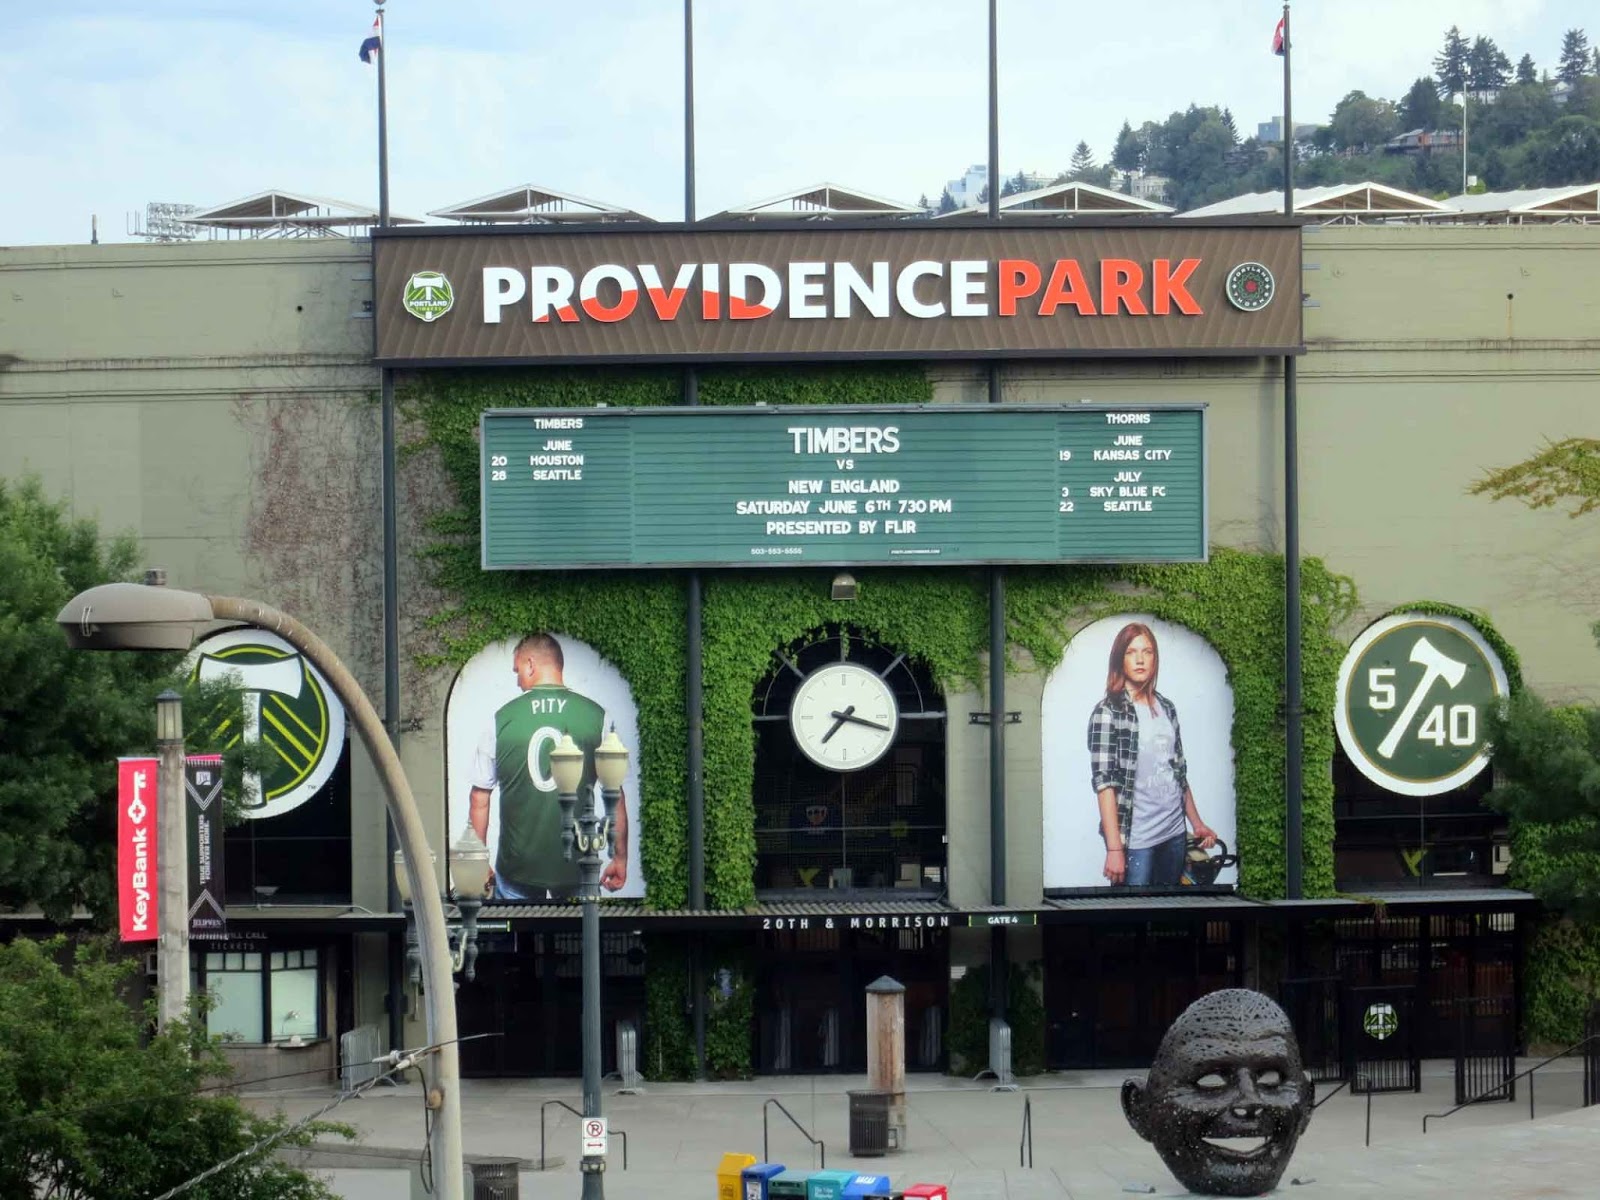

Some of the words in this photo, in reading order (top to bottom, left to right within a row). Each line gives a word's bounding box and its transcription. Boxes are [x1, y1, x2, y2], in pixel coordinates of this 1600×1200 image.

[533, 418, 584, 430] TIMBERS
[1106, 413, 1151, 425] THORNS
[542, 440, 573, 451] JUNE
[787, 426, 900, 454] TIMBERS
[1113, 435, 1143, 446] JUNE
[491, 455, 508, 467] 20
[530, 455, 584, 466] HOUSTON
[1059, 450, 1071, 461] 19
[1093, 450, 1140, 461] KANSAS
[1144, 449, 1172, 461] CITY
[491, 470, 507, 481] 28
[533, 469, 583, 481] SEATTLE
[1113, 471, 1142, 482] JULY
[788, 480, 823, 494] NEW
[830, 479, 900, 494] ENGLAND
[1061, 487, 1069, 497] 3
[1089, 486, 1114, 497] SKY
[1119, 486, 1148, 497] BLUE
[1152, 486, 1166, 497] FC
[736, 500, 811, 514] SATURDAY
[818, 500, 857, 514] JUNE
[864, 499, 891, 513] 6TH
[929, 498, 952, 513] PM
[1059, 501, 1074, 512] 22
[1103, 501, 1153, 512] SEATTLE
[766, 520, 852, 534] PRESENTED
[858, 520, 878, 534] BY
[885, 519, 916, 534] FLIR
[1368, 667, 1396, 710] 5
[531, 698, 567, 714] PITY
[1417, 704, 1476, 746] 40
[132, 828, 150, 932] KeyBank
[763, 915, 808, 929] 20TH
[825, 919, 834, 929] &
[851, 915, 949, 929] MORRISON
[988, 917, 1010, 925] GATE
[1011, 916, 1018, 924] 4
